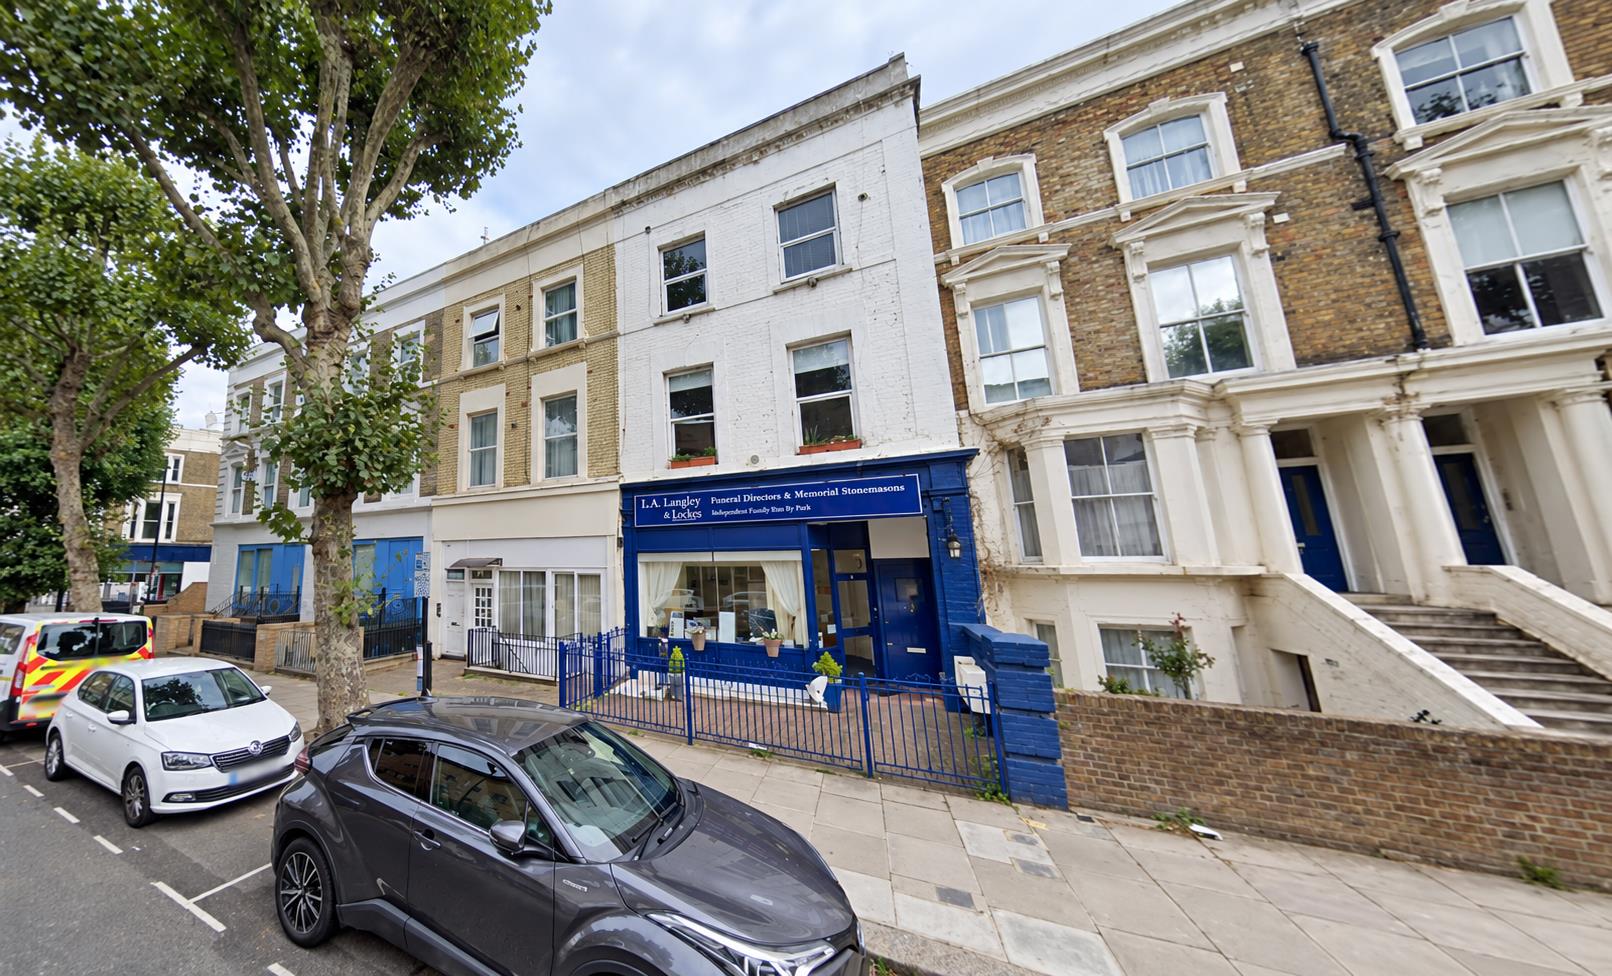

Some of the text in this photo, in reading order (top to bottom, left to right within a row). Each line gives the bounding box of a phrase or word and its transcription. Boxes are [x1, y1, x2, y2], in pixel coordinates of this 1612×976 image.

[710, 484, 905, 505] Funeral Directors & Memorial Stonemasons
[663, 496, 701, 510] Langley
[663, 511, 671, 519] &
[711, 507, 748, 518] Independent
[785, 505, 794, 514] By
